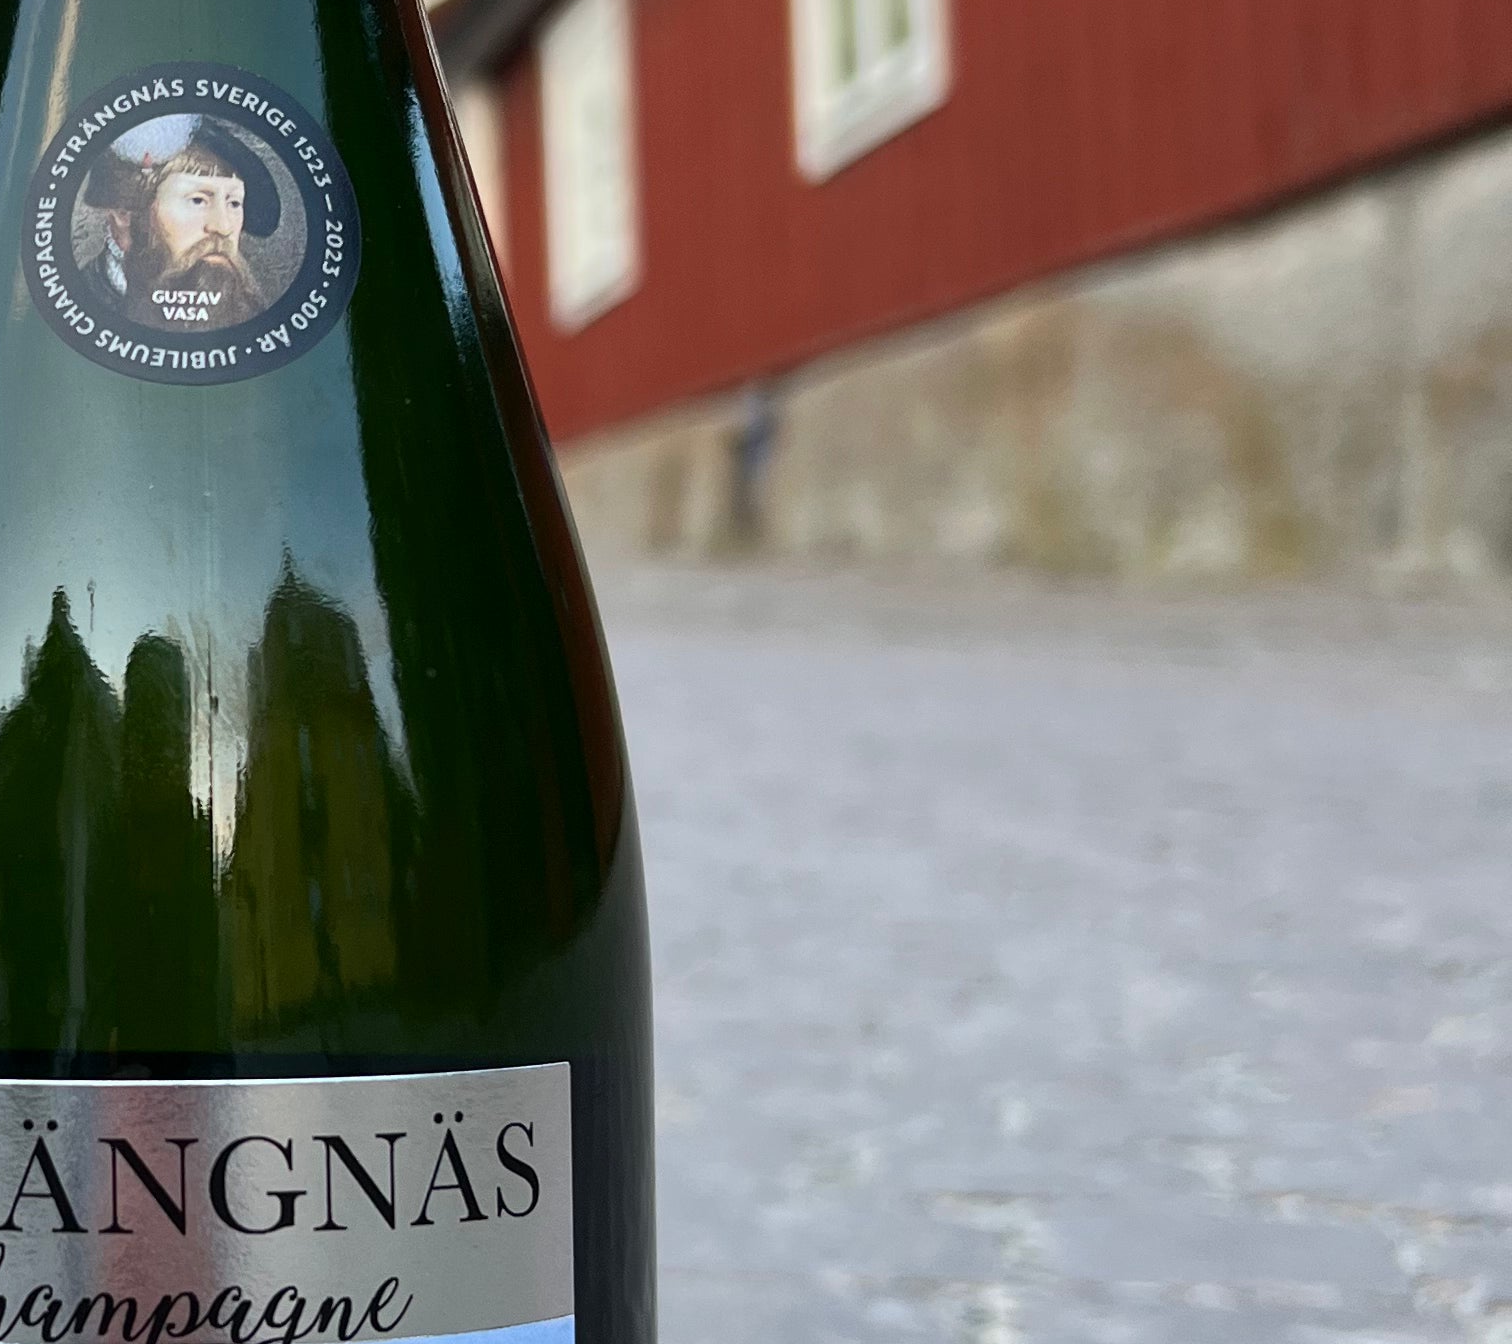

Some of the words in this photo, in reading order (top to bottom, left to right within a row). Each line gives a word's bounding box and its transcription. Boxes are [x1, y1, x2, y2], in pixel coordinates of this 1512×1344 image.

[52, 78, 185, 179] STRÄNGNÄS
[195, 79, 297, 138] SVERIGE
[293, 136, 333, 188] 1523
[35, 196, 96, 336] CHAMPAGNE
[321, 220, 345, 277] 2023
[151, 289, 222, 306] GUSTAV
[162, 306, 209, 322] VASA
[290, 288, 328, 332] 500
[95, 332, 238, 370] JUBILEUMS
[256, 324, 292, 354] ÅR
